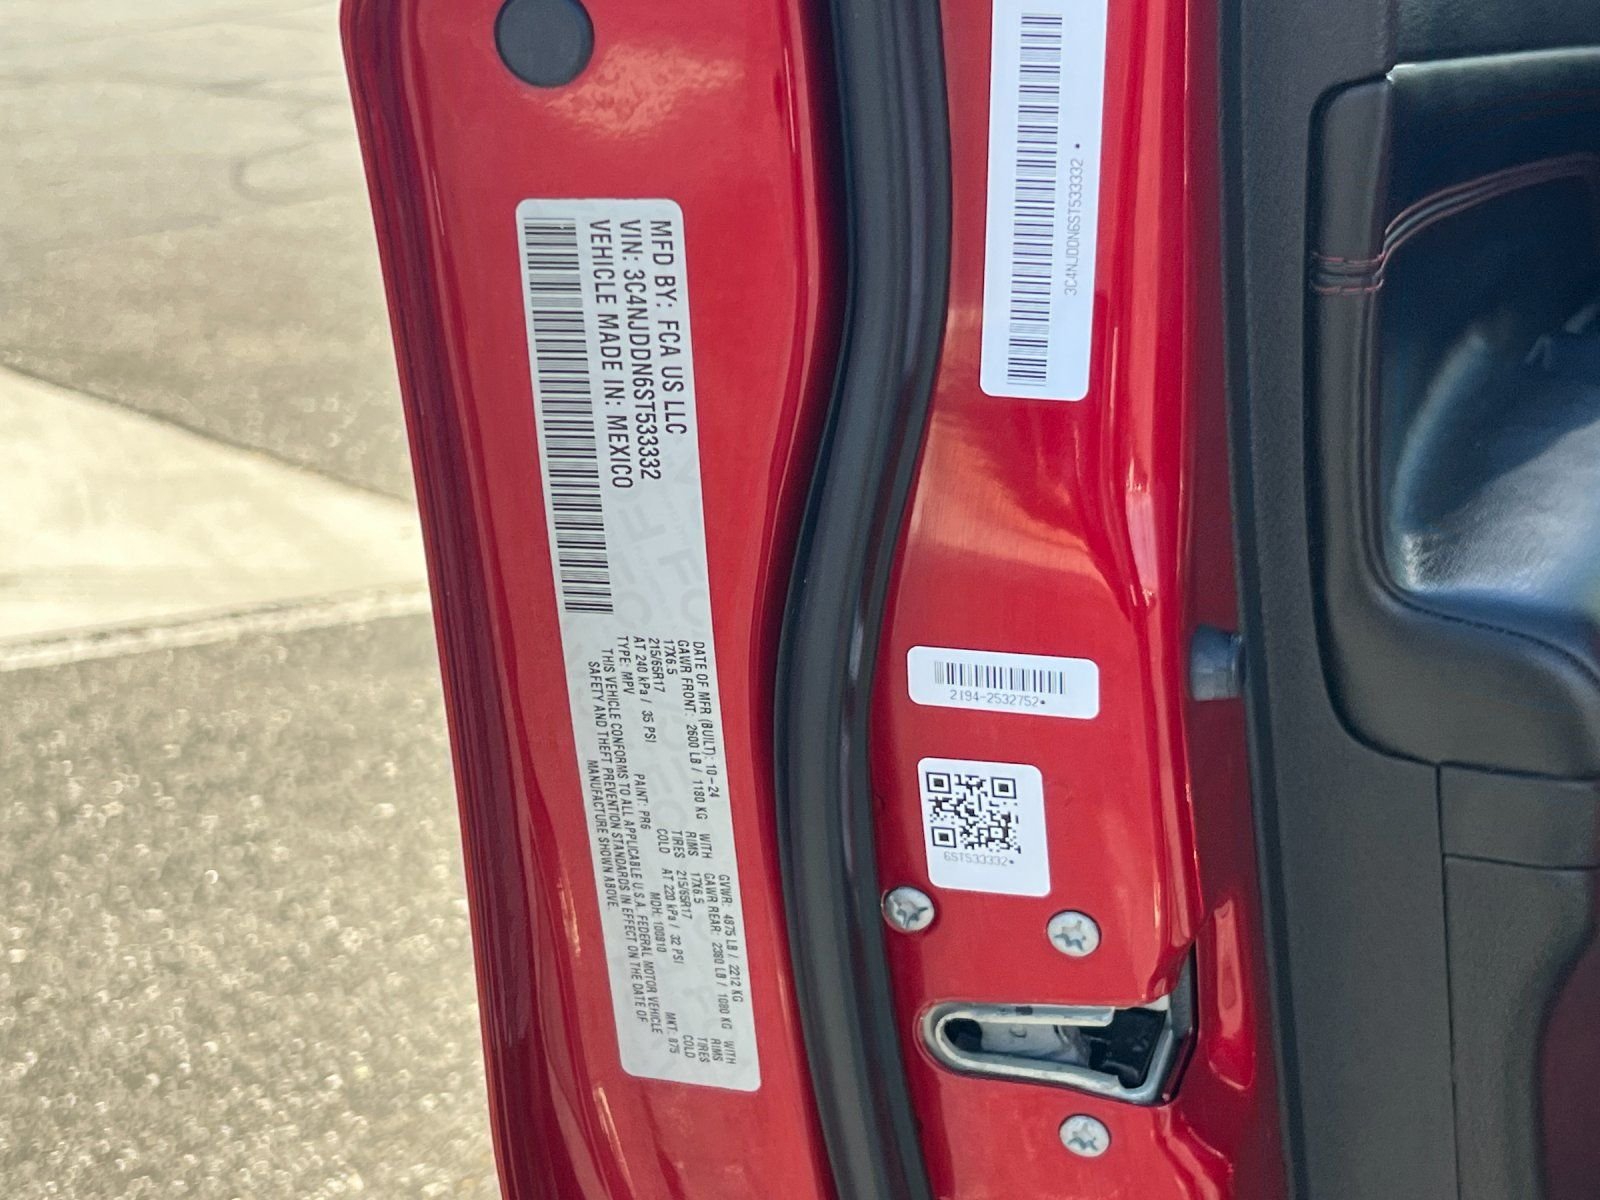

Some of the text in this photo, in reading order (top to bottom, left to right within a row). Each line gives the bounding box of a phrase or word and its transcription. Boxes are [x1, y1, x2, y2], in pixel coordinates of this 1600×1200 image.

[618, 219, 643, 260] VIN:
[649, 219, 687, 434] MFD BY: FCA US LLC
[588, 219, 633, 488] VEHICLE MADE IN: MEXICO
[622, 269, 662, 480] 3C4NJDDN6ST533332
[632, 636, 645, 649] AT
[692, 641, 706, 669] DATE
[601, 648, 615, 672] THIS
[616, 635, 634, 694] TYPE: MPV
[635, 654, 648, 672] 240
[677, 639, 691, 673] GAWR
[637, 676, 650, 695] kPa
[695, 673, 708, 687] OF
[604, 676, 621, 719] VEHICLE
[681, 677, 696, 717] FRONT:
[697, 691, 711, 714] MFR
[641, 710, 653, 722] 35
[643, 725, 655, 743] PSI
[686, 724, 699, 748] 2600
[698, 718, 715, 759] (BUILT):
[610, 722, 628, 779] CONFORMS
[648, 637, 684, 858] 215/65R17 TIRES
[662, 638, 698, 856] 17X6.5 RIMS
[689, 751, 701, 763] LB
[618, 782, 630, 795] TO
[633, 773, 651, 829] PAINT: PR6
[692, 779, 705, 802] 1180
[620, 798, 633, 817] ALL
[695, 806, 707, 819] KG
[586, 759, 618, 910] MANUFACTURE SHOWN ABOVE.
[587, 661, 647, 1023] SAFETY AND THEFT PREVENTION STANDARDS IN EFFECT ON THE DATE OF
[655, 827, 670, 854] COLD
[698, 833, 712, 858] WITH
[623, 819, 642, 879] APPLICABLE
[661, 867, 673, 881] AT
[663, 883, 675, 900] 220
[703, 872, 718, 903] GAWR
[718, 873, 732, 907] GVWR:
[665, 903, 678, 921] kPa
[707, 905, 721, 935] REAR:
[722, 913, 735, 936] 4875
[636, 914, 652, 957] FEDERAL
[669, 933, 681, 945] 32
[725, 938, 737, 951] LB
[671, 948, 683, 964] PSI
[675, 869, 709, 1063] 215/65R17 TIRES
[689, 871, 722, 1062] 17X6.5 RIMS
[642, 960, 657, 993] MOTOR
[714, 967, 726, 978] LB
[728, 963, 741, 986] 2212
[731, 989, 742, 1002] KG
[647, 995, 662, 1033] VEHICLE
[720, 1016, 732, 1029] KG
[681, 1033, 695, 1058] COLD
[722, 1039, 736, 1064] WITH
